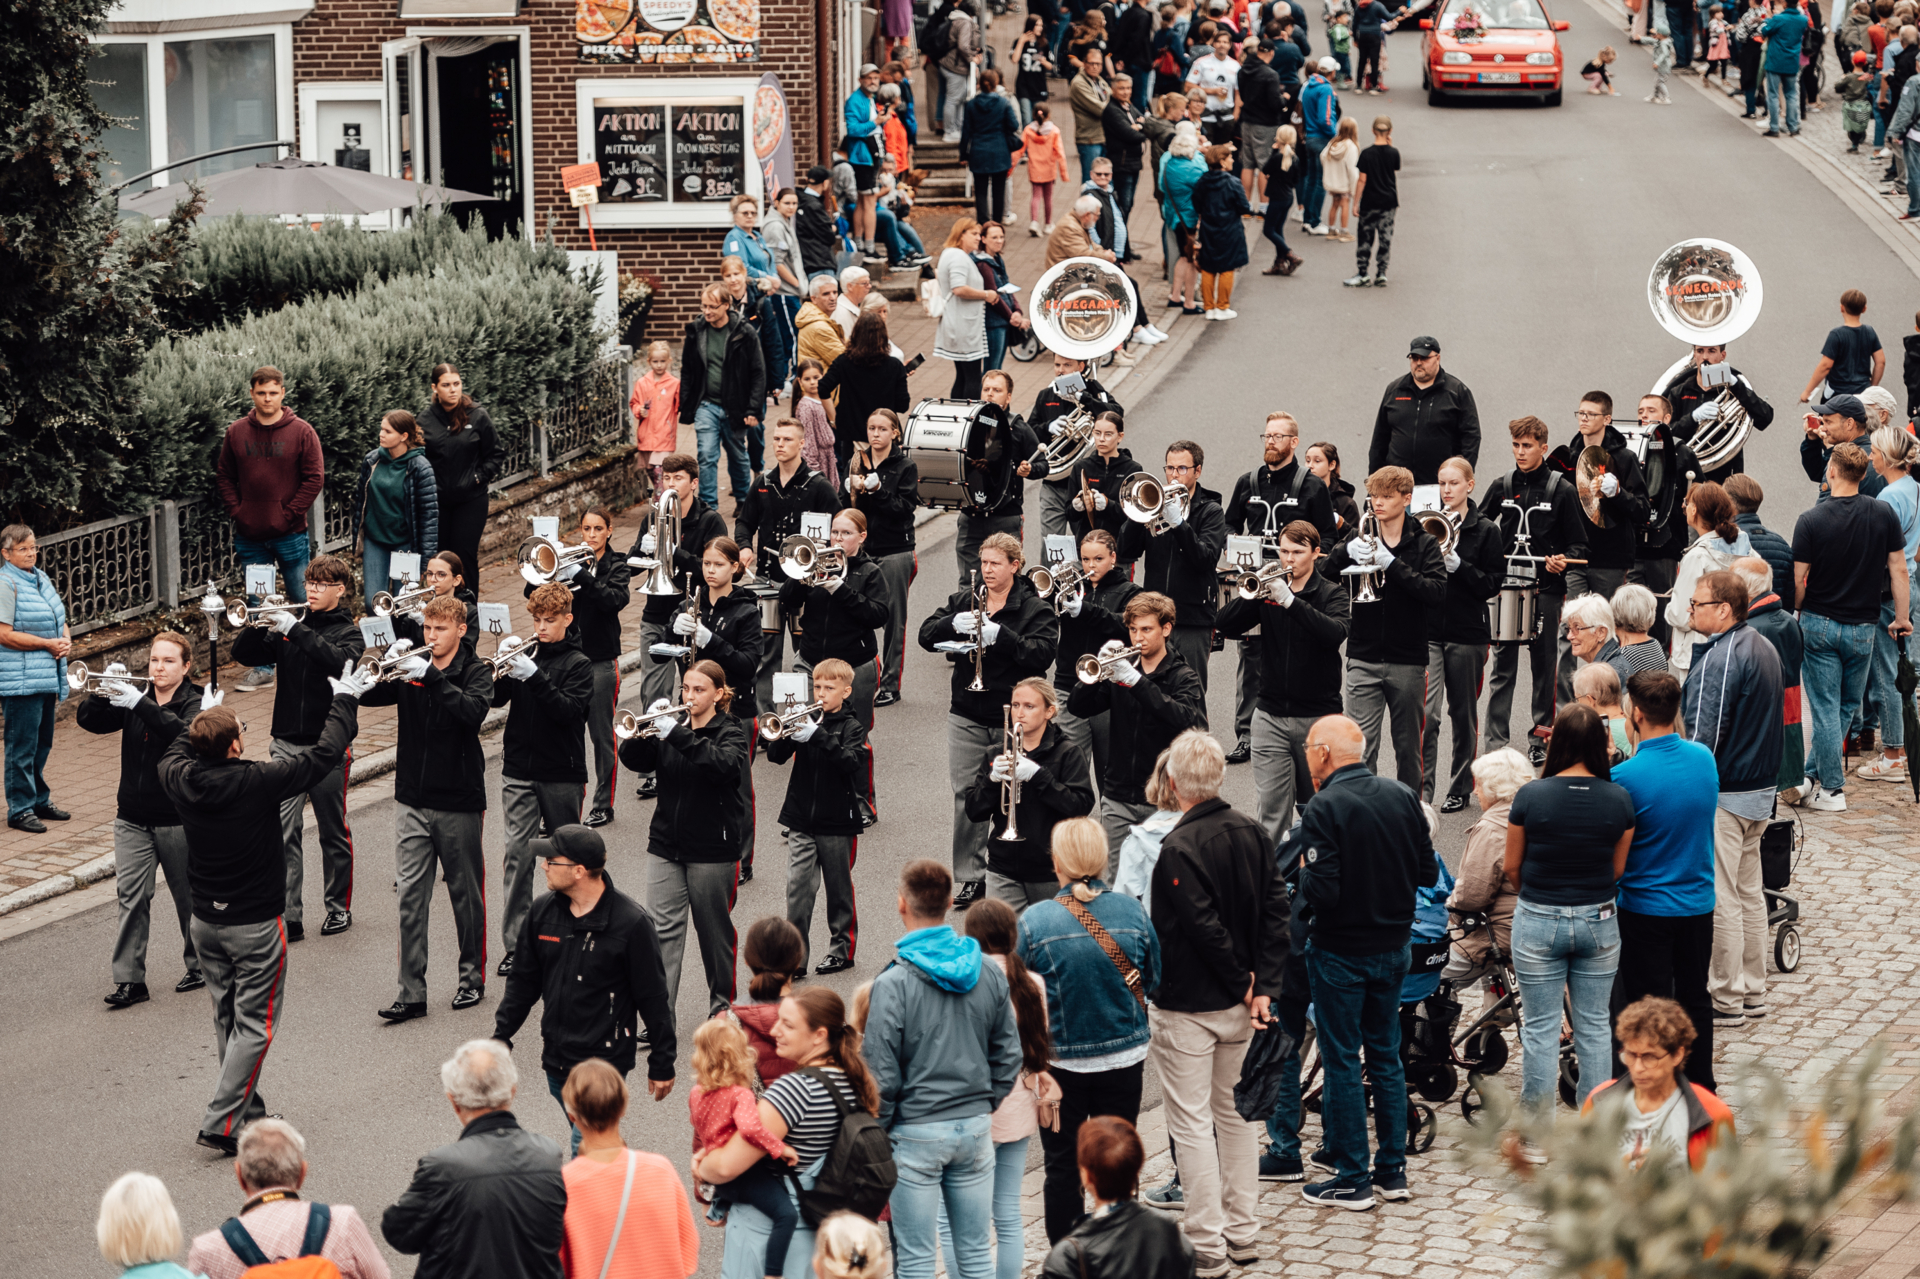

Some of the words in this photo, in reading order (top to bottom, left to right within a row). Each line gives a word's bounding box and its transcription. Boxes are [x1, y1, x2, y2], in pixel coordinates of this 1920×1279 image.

[643, 1, 692, 9] SPEEDY'S
[582, 45, 626, 55] PIZZA
[638, 44, 694, 54] BURGER
[706, 44, 755, 54] PASTA
[598, 113, 661, 131] AKTION
[676, 112, 740, 131] AKTION
[697, 133, 716, 141] am
[605, 144, 657, 155] MITTWOCH
[676, 142, 741, 154] DONNERSTAG
[705, 159, 735, 180] Burger
[1665, 279, 1744, 296] LEINEGARDE
[1045, 299, 1120, 310] LEINEGARDE
[1426, 952, 1448, 966] drive
